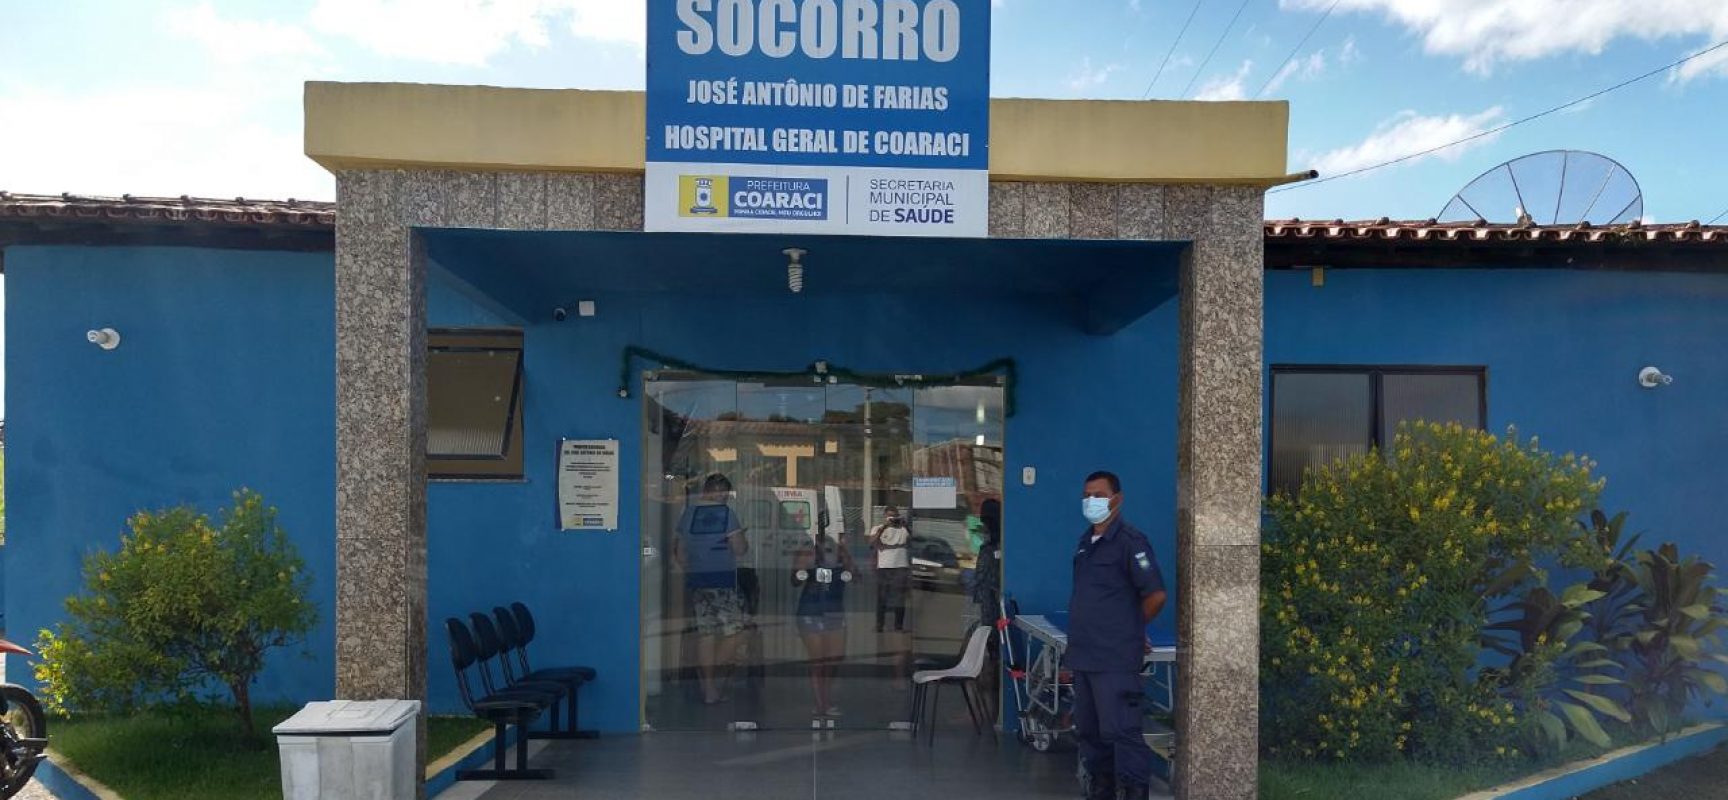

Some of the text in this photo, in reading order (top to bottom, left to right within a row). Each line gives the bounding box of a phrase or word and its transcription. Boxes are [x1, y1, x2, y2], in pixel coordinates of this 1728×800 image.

[677, 0, 961, 63] SOCORRO
[687, 77, 949, 111] JOSÉ ANTÔNIO DE FARIAS
[665, 125, 969, 157] HOSPITAL GERAL DE COARACI
[747, 180, 811, 191] PREFEITURA
[870, 179, 954, 191] SECRETARIA
[734, 191, 822, 209] COARACI
[870, 191, 955, 206] MUNICIPAL
[869, 204, 955, 224] DE SAÚDE
